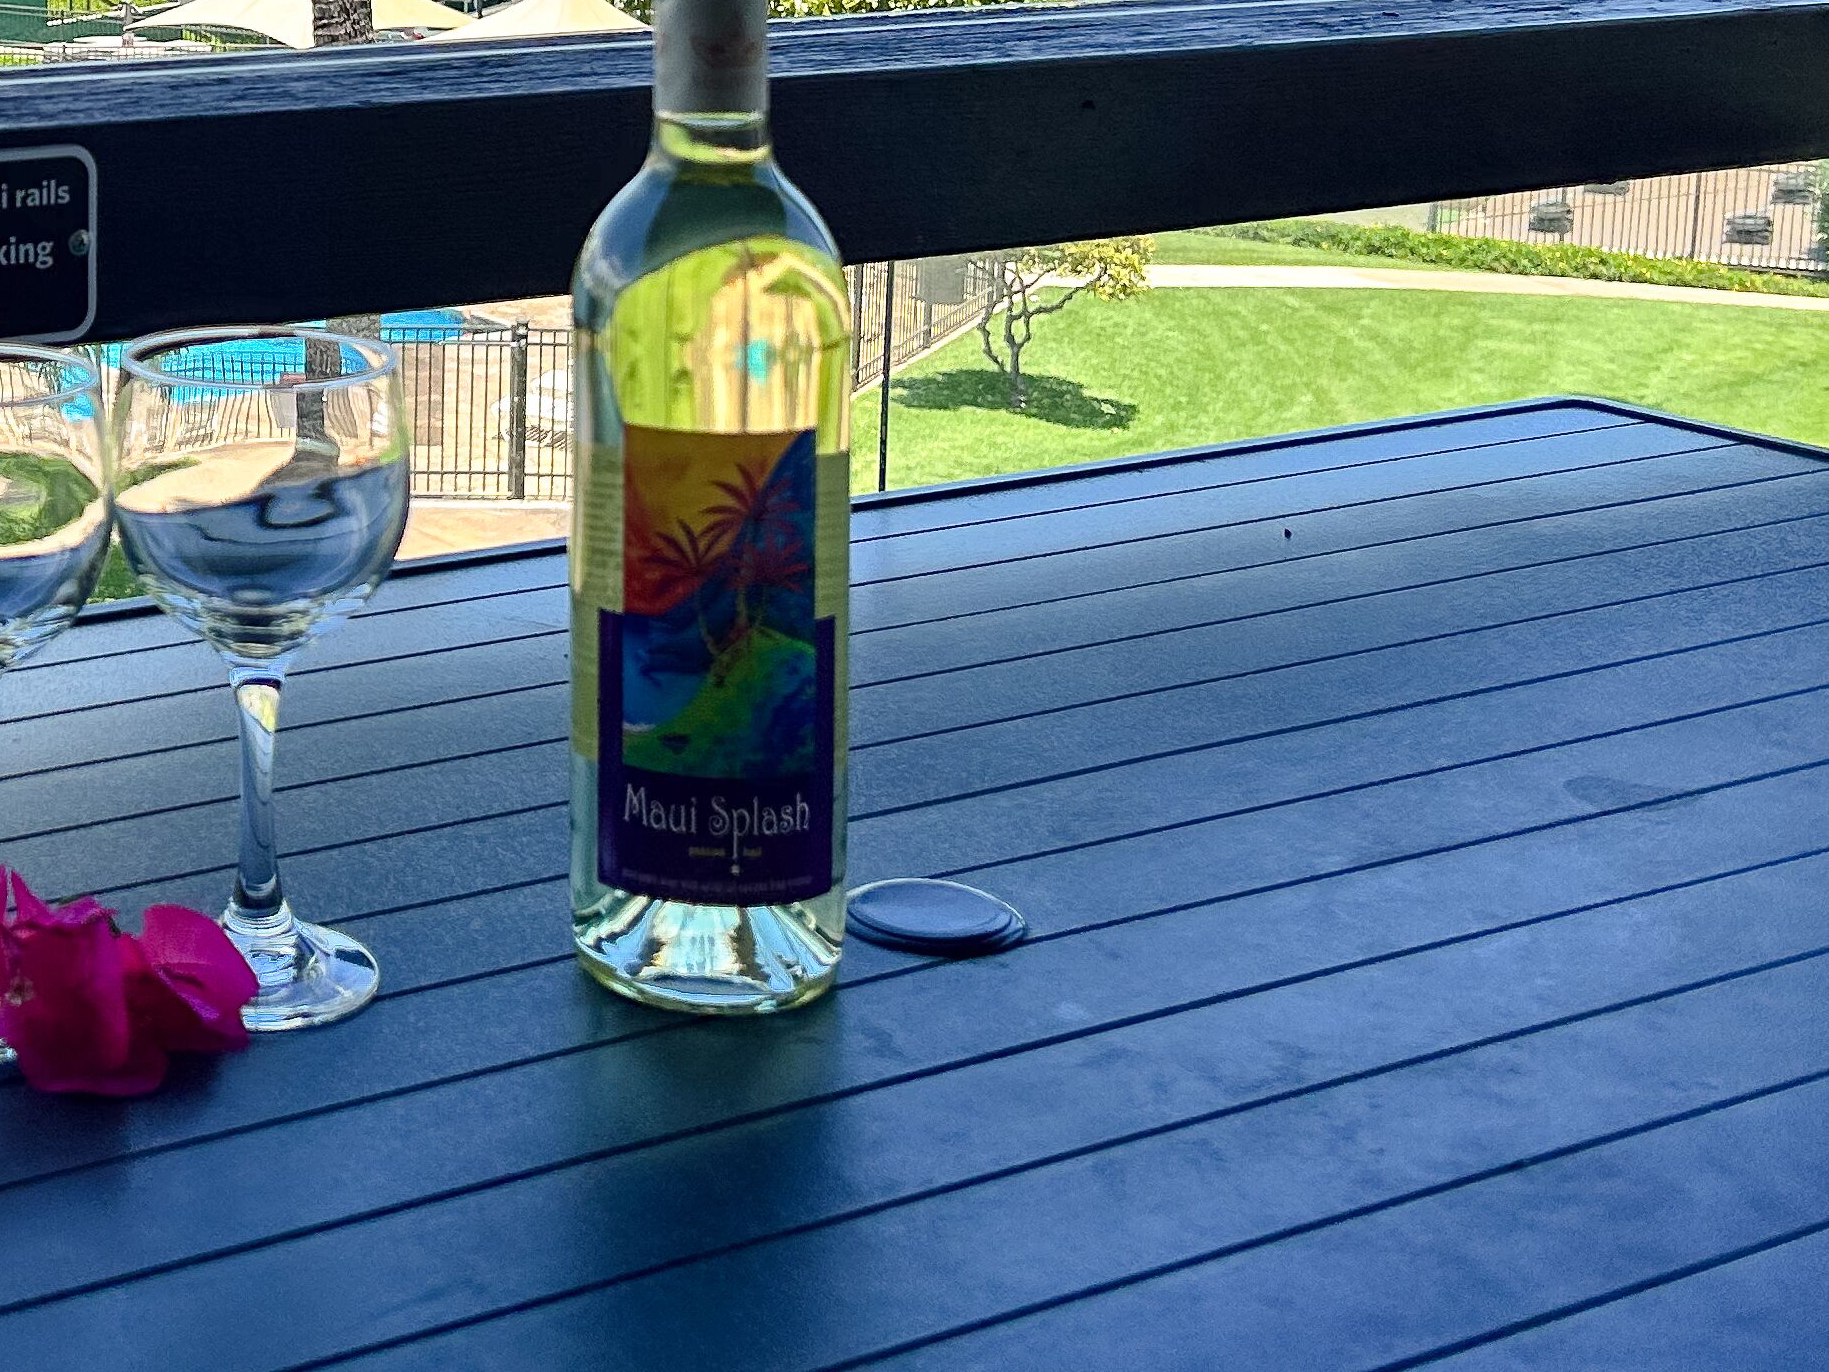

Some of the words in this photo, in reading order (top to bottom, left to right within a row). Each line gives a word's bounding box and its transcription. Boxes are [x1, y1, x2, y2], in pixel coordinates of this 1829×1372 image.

[15, 179, 71, 208] rails
[624, 782, 698, 834] Maui
[708, 792, 811, 861] Splash
